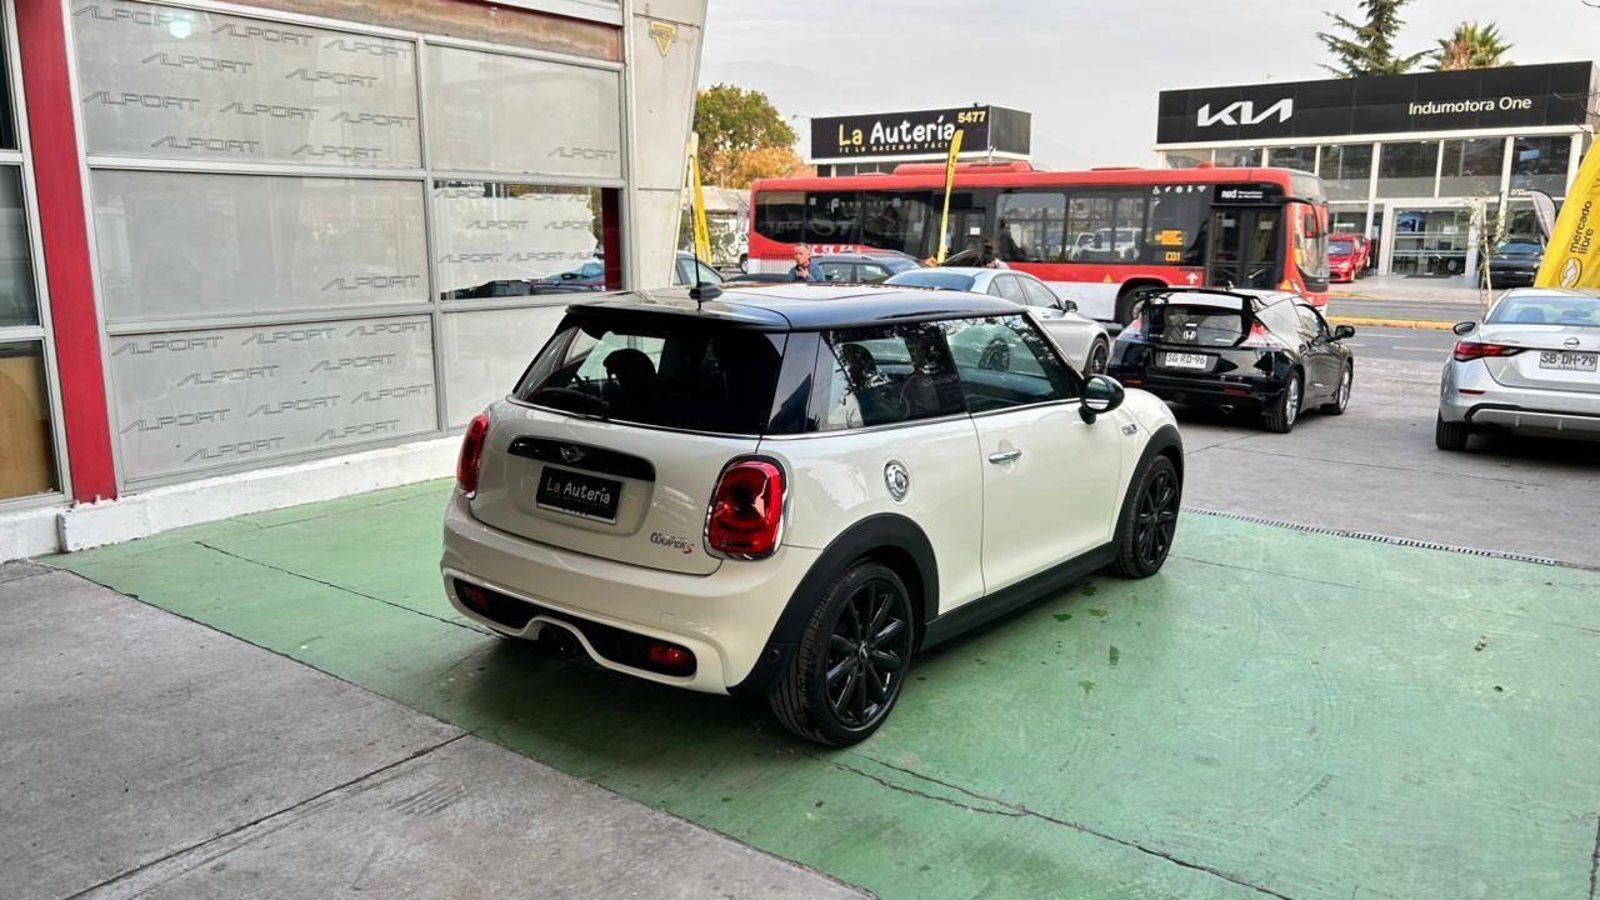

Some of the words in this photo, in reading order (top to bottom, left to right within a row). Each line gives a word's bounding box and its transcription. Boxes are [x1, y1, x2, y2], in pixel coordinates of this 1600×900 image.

[211, 23, 313, 47] ALPORT
[323, 39, 413, 59] ALPORT
[142, 53, 252, 74] ALPORT
[286, 68, 378, 88] ALPORT
[83, 90, 200, 110] ALPORT
[1408, 100, 1495, 115] Indumotora
[1499, 96, 1532, 110] One
[219, 102, 320, 120] ALPORT
[329, 111, 415, 128] ALPORT
[957, 110, 986, 124] 5477
[1197, 98, 1293, 126] KIA
[838, 123, 863, 146] La
[870, 114, 955, 145] Autería
[151, 135, 260, 153] ALPORT
[291, 144, 383, 159] ALPORT
[1570, 201, 1593, 254] mercado
[1577, 228, 1595, 255] libre
[321, 274, 421, 291] ALPORT
[241, 327, 336, 346] ALPORT
[346, 320, 429, 338] ALPORT
[111, 336, 224, 357] ALPORT
[309, 353, 396, 373] ALPORT
[177, 364, 279, 387] ALPORT
[350, 383, 433, 404] ALPORT
[247, 394, 340, 418] ALPORT
[120, 409, 230, 434] ALPORT
[314, 419, 400, 443] ALPORT
[184, 436, 285, 463] ALPORT
[546, 476, 561, 495] La
[563, 480, 611, 505] Autería
